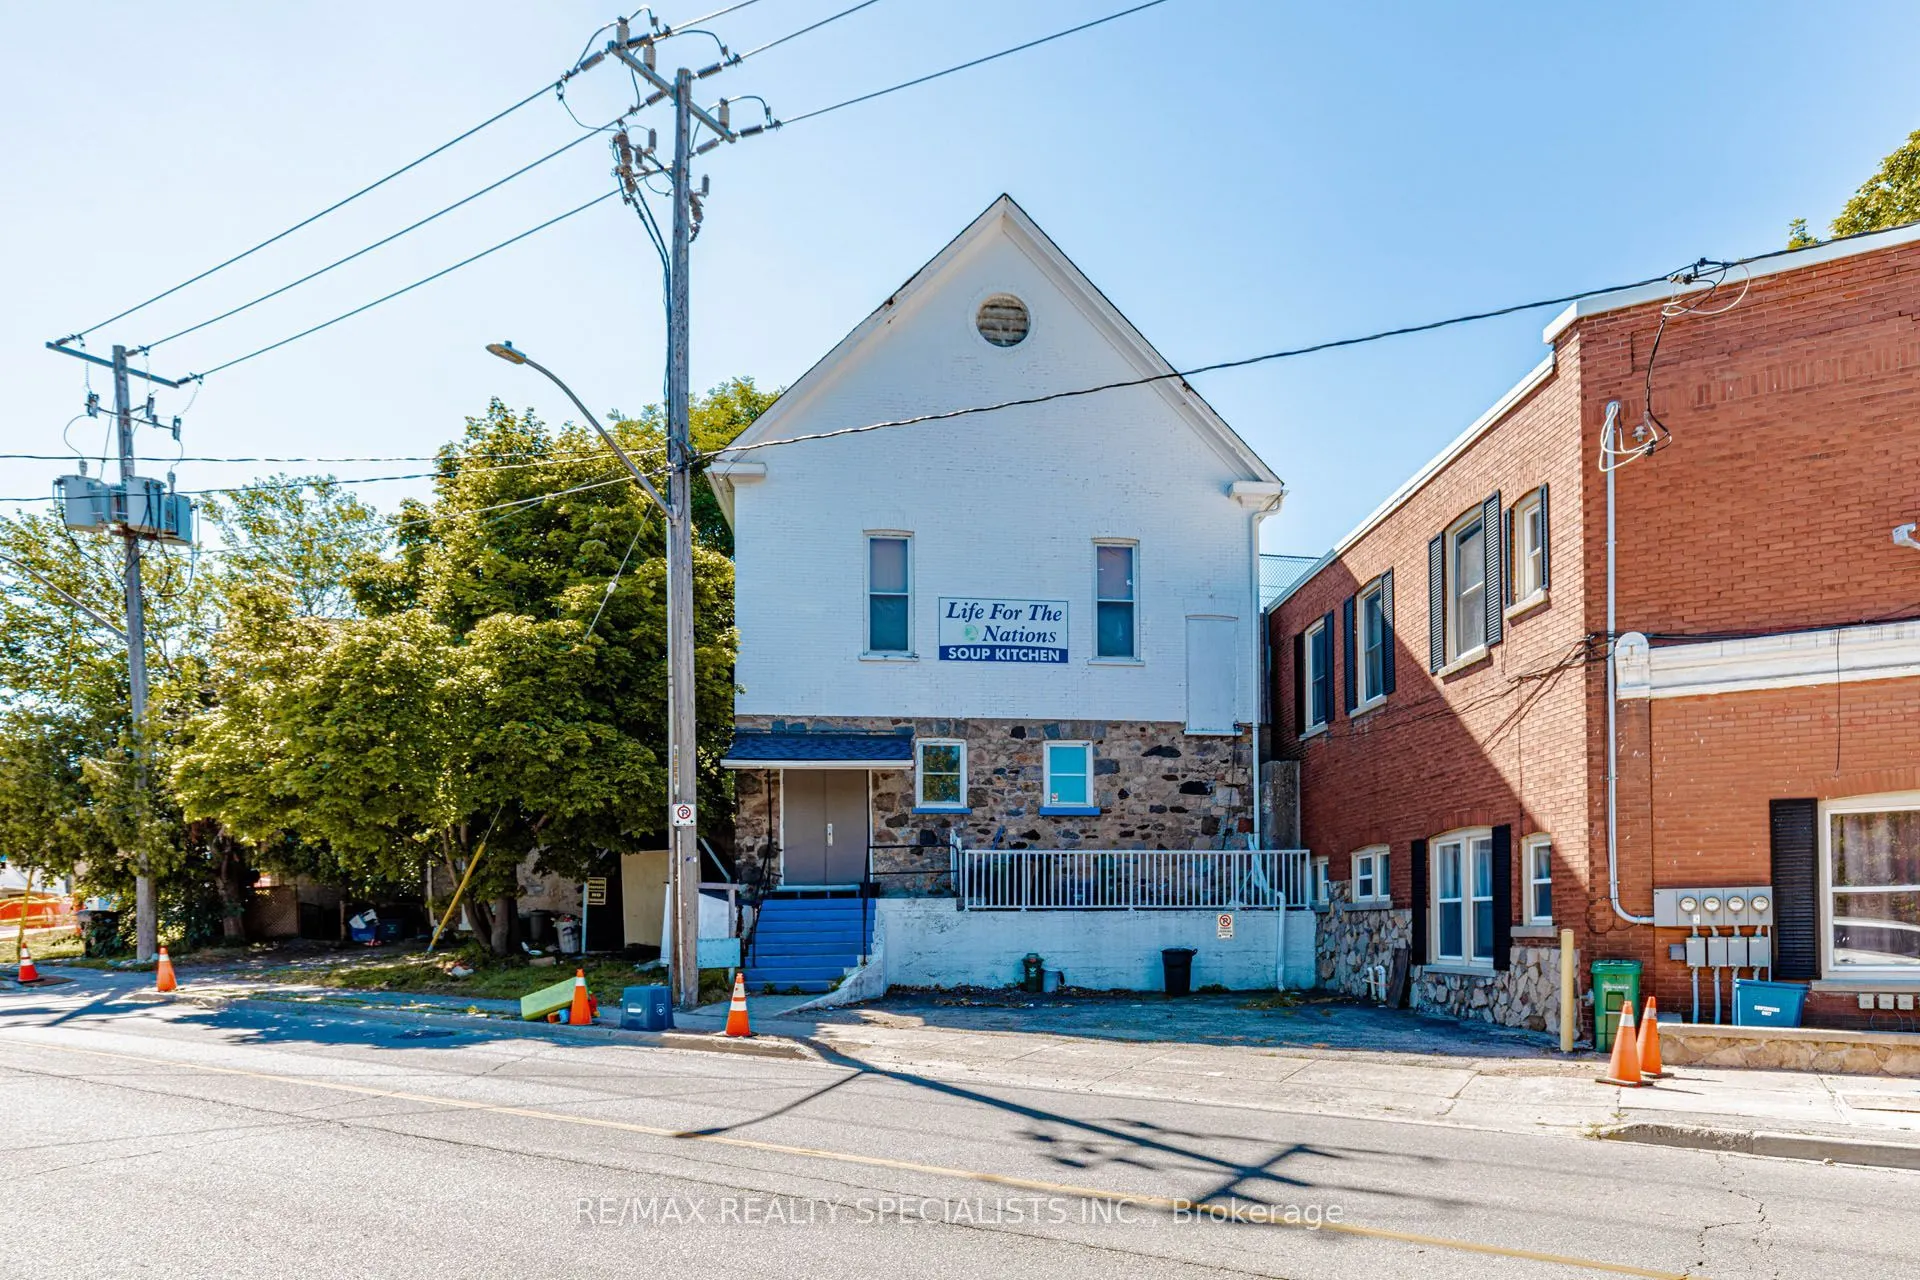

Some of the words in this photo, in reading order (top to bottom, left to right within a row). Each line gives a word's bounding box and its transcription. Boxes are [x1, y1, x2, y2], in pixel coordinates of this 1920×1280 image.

[946, 602, 984, 623] Life
[989, 603, 1023, 621] For
[1029, 604, 1063, 622] The
[982, 625, 1057, 643] Nations
[948, 647, 991, 660] SOUP
[995, 648, 1060, 662] KITCHEN
